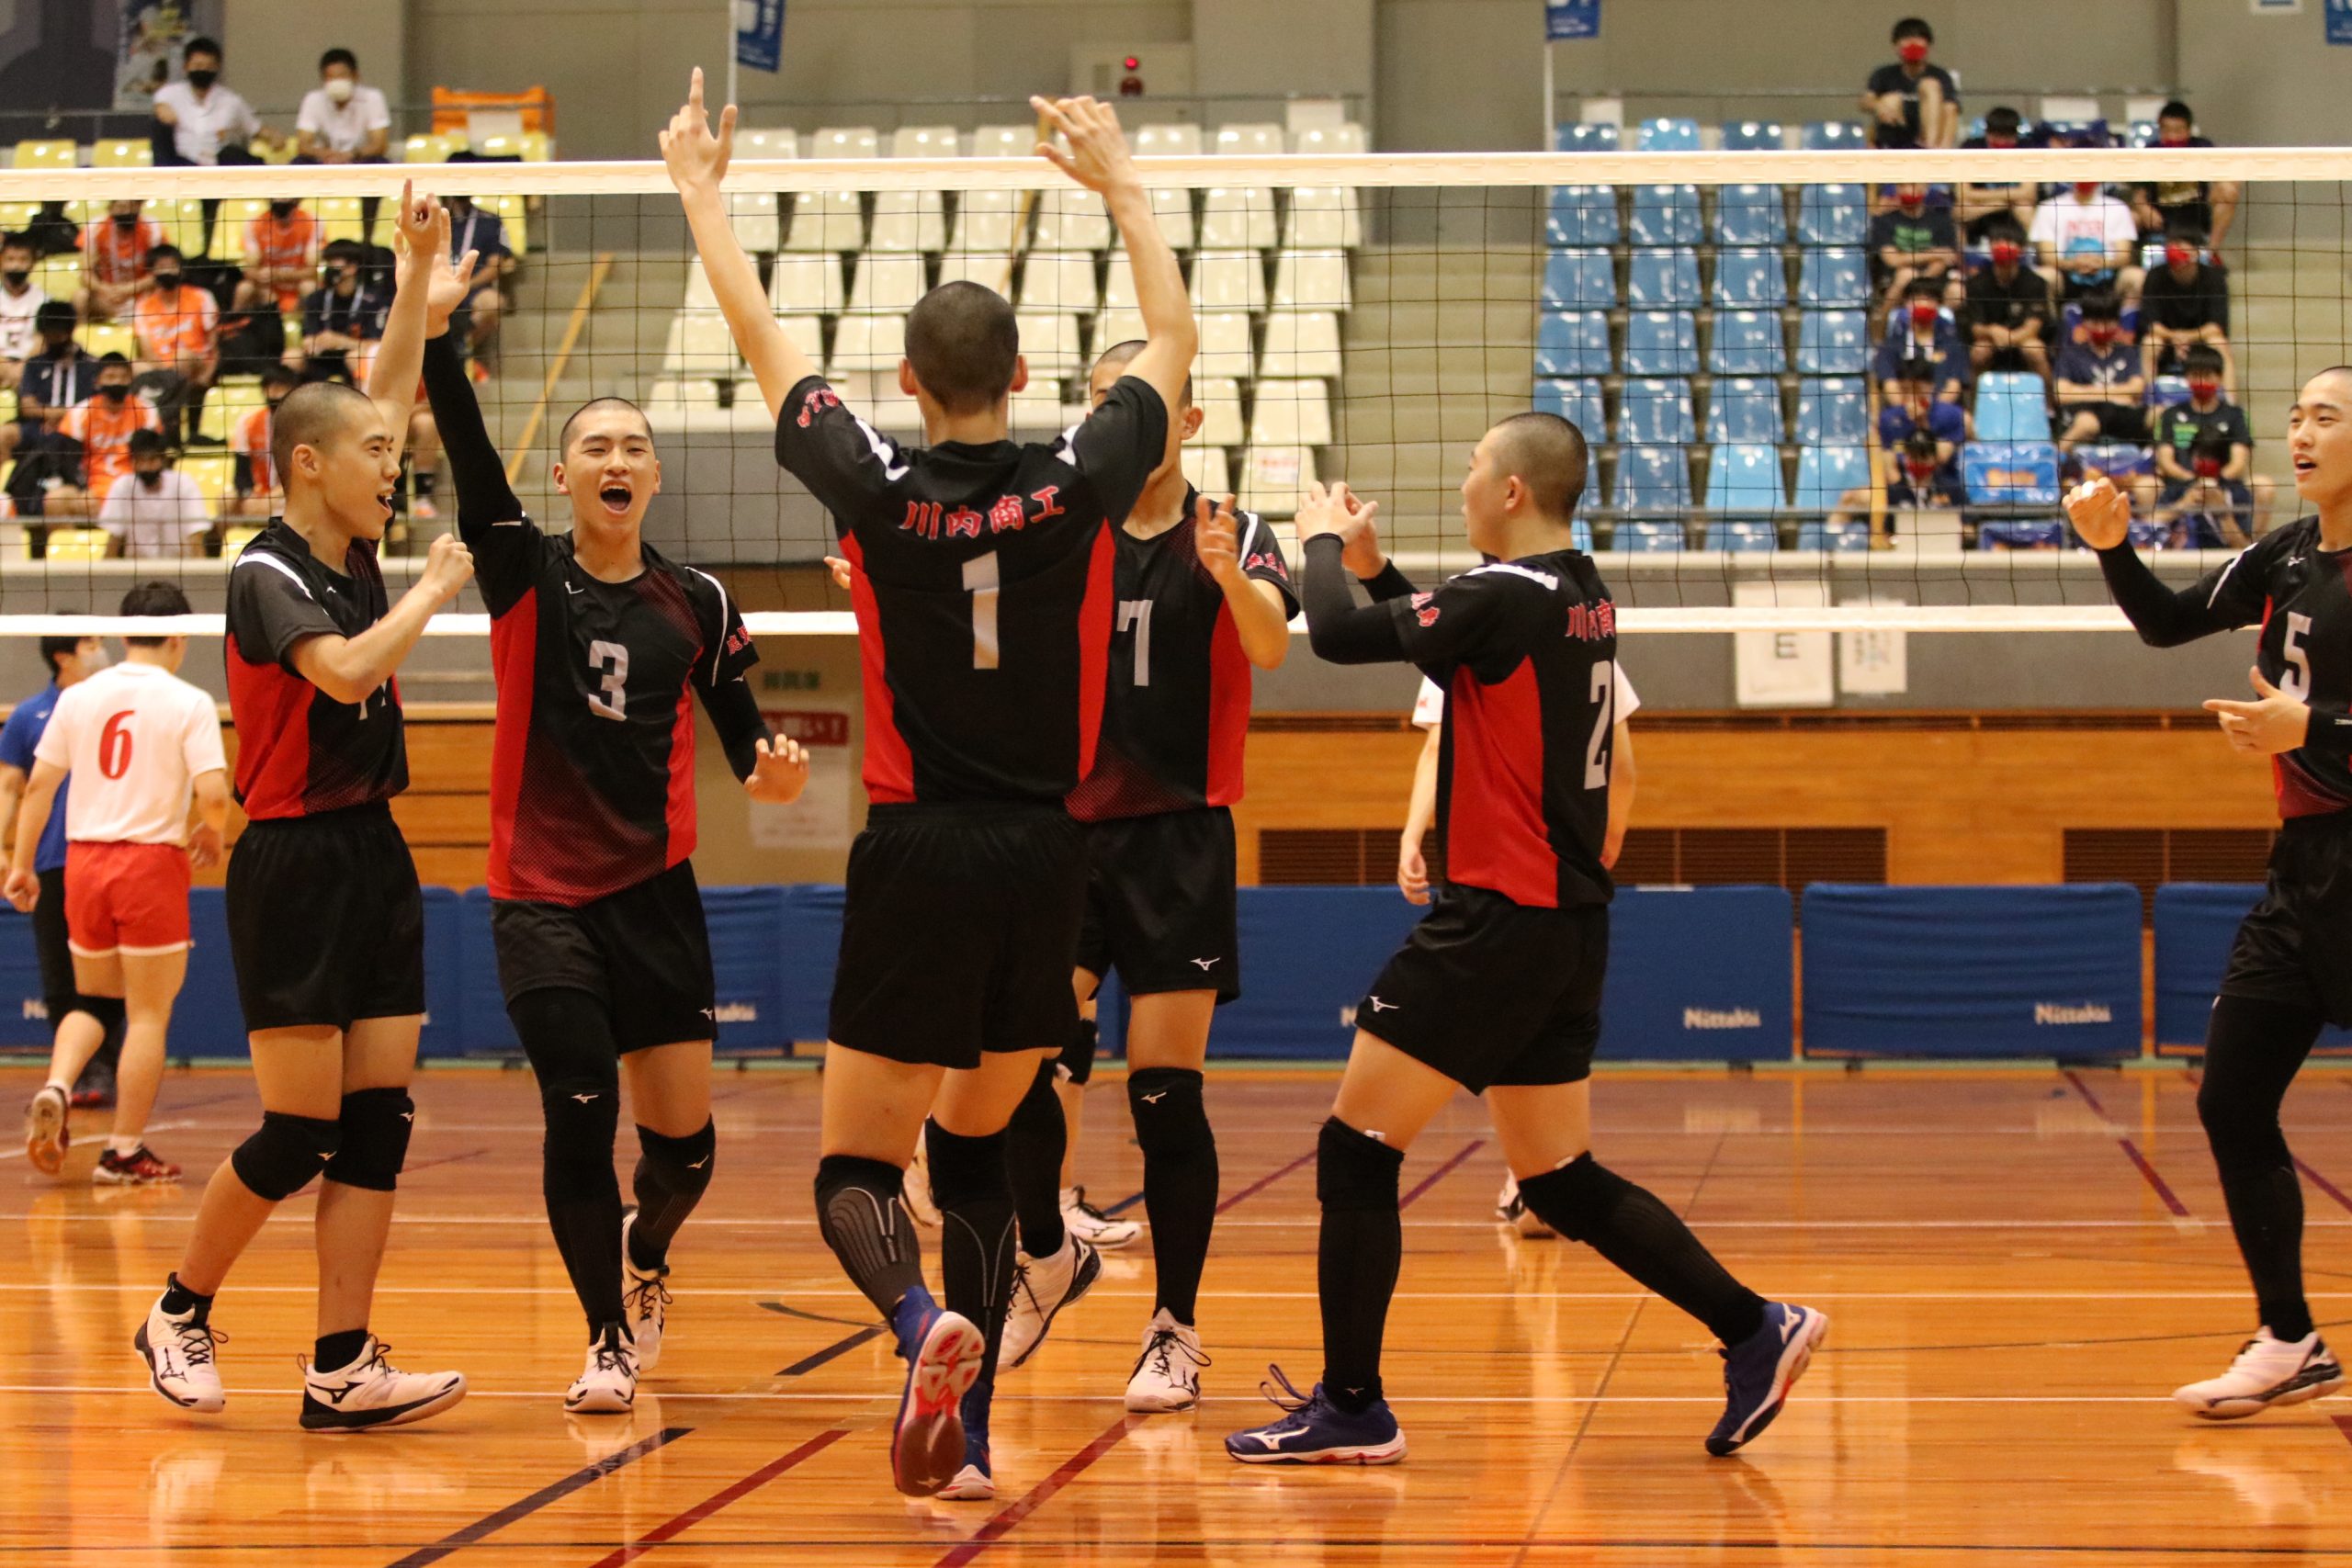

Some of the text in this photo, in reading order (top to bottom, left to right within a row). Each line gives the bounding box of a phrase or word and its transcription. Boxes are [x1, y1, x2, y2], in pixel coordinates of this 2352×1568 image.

[899, 485, 1065, 540] 川内商工
[962, 550, 1000, 670] 1
[1116, 600, 1153, 687] 7
[1565, 598, 1615, 641] 川内商
[588, 639, 629, 722] 3
[2279, 611, 2312, 704] 5
[98, 709, 136, 781] 6
[1584, 660, 1611, 790] 2
[1683, 1007, 1761, 1029] Nittaku
[2034, 1003, 2112, 1025] Nittaku
